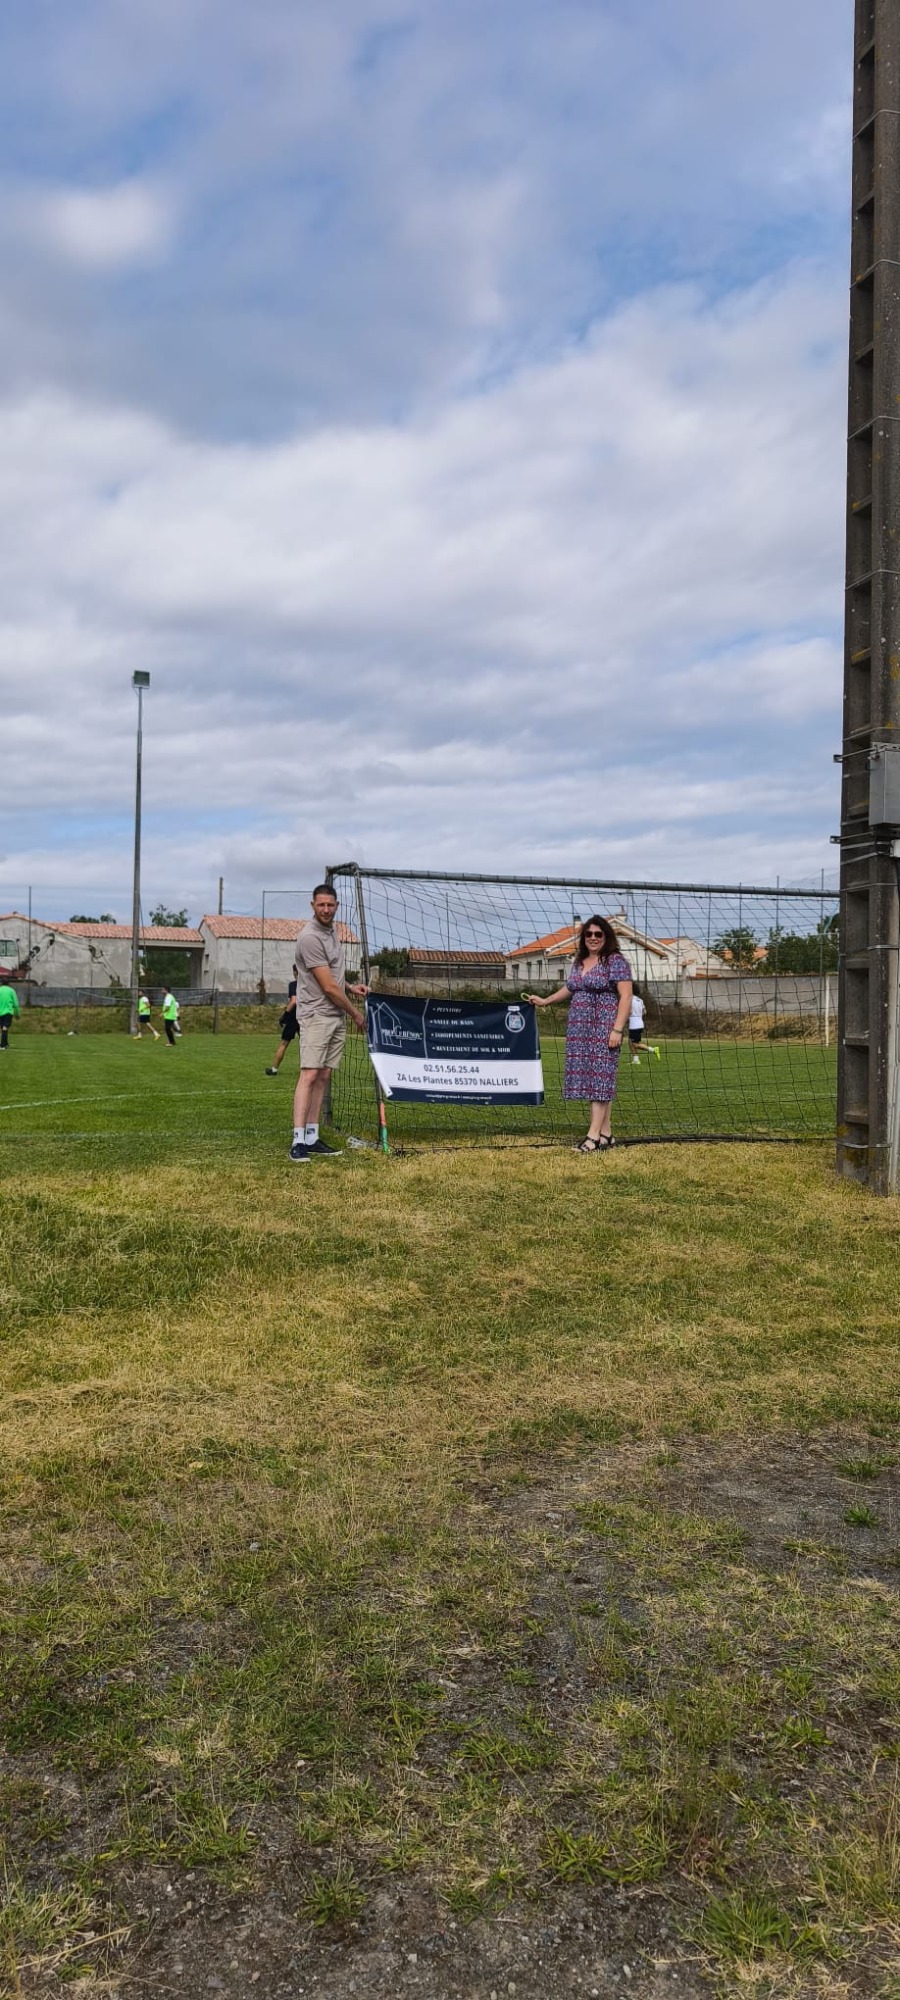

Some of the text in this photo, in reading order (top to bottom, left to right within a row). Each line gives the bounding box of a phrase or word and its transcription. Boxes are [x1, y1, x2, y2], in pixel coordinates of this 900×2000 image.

[423, 1064, 480, 1074] 02.51.56.25.44
[396, 1073, 519, 1086] ZA Les Plantes 85370 NALLIERS
